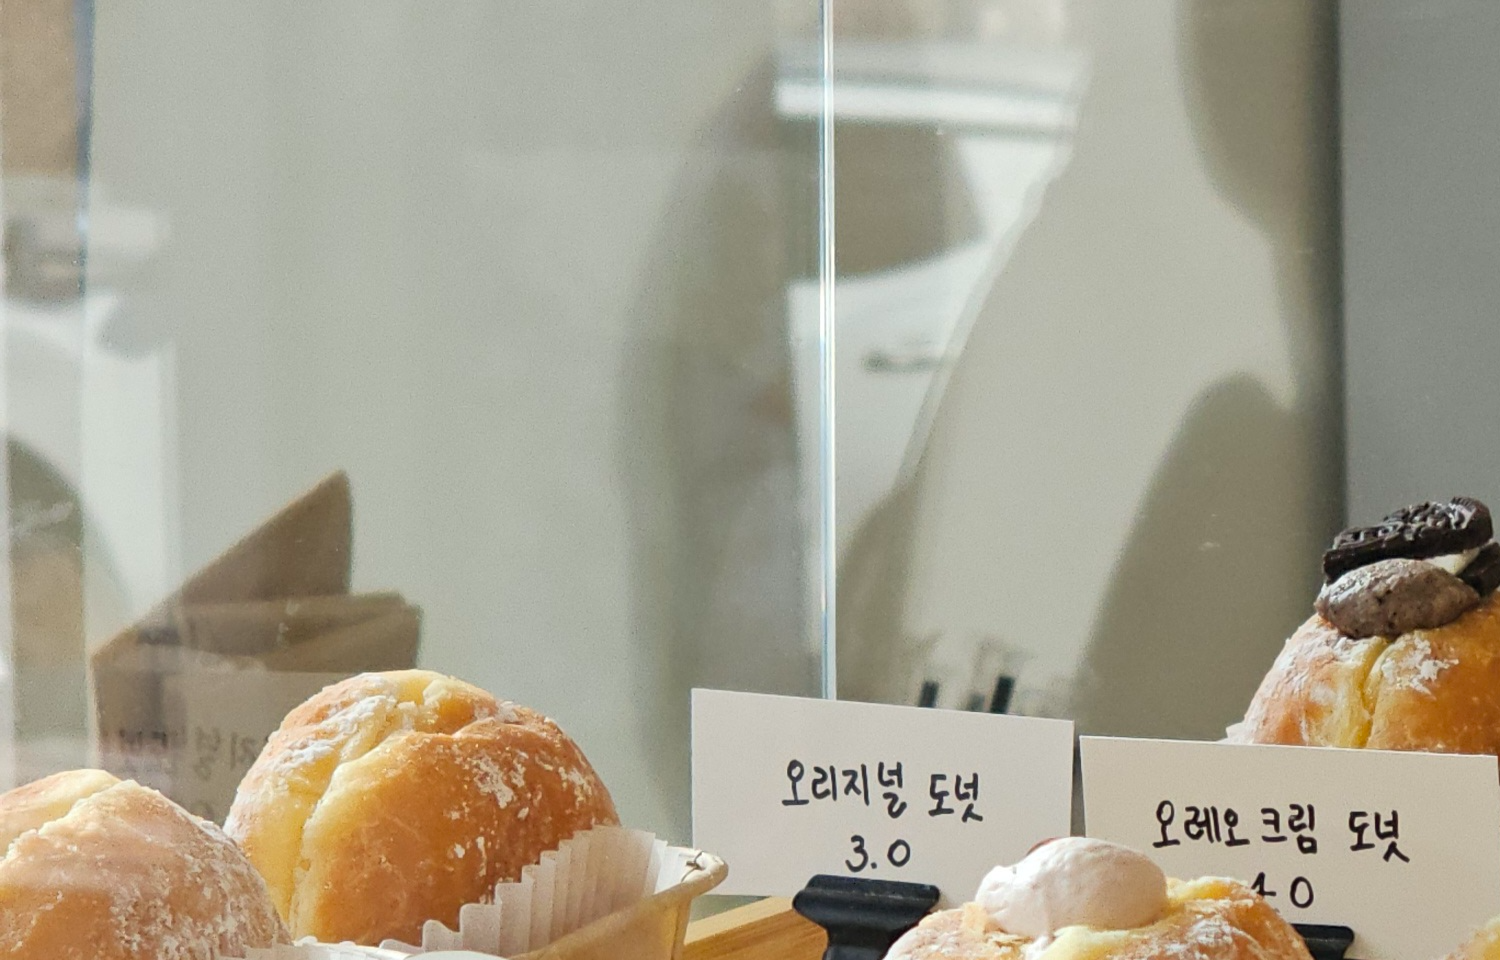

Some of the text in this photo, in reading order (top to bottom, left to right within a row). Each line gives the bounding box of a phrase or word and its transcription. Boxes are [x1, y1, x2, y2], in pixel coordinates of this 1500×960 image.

[781, 759, 984, 823] 오리지널 도넛
[845, 834, 911, 873] 3.0
[1152, 799, 1411, 864] 오레오 크림 도넛
